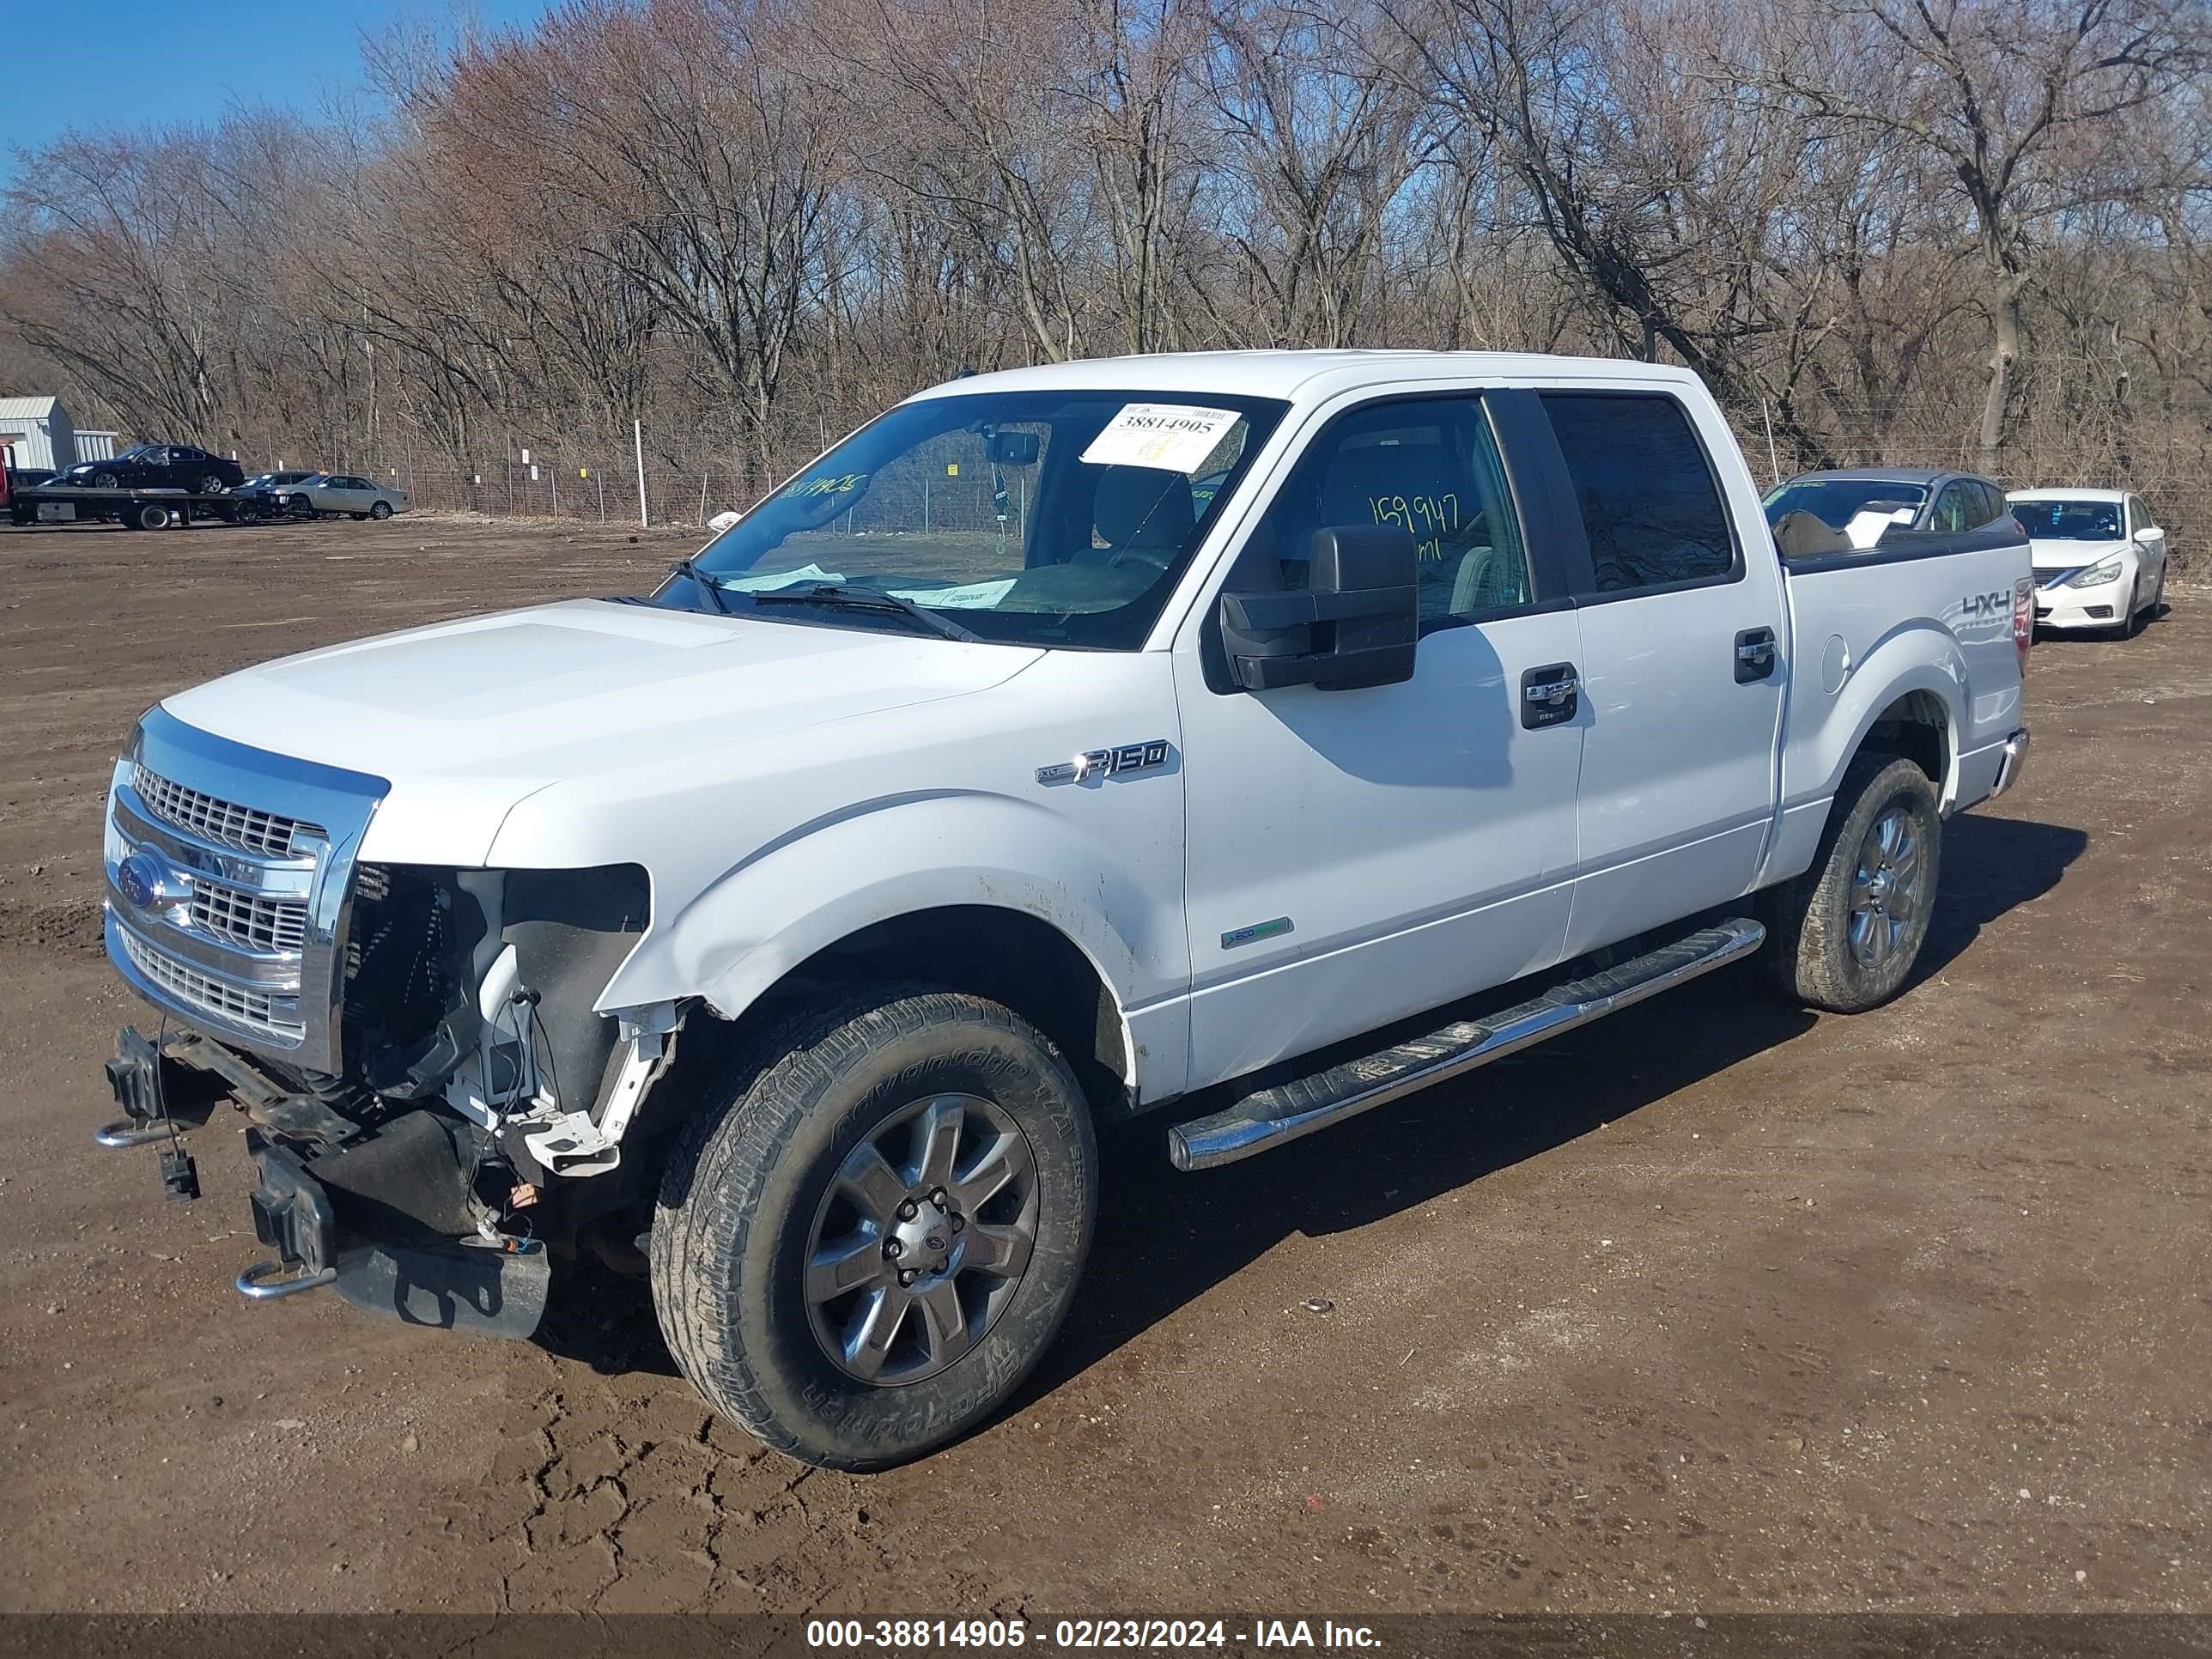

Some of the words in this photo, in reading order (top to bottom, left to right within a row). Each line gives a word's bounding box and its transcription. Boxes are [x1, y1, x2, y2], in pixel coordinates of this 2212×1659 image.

[1119, 416, 1215, 434] 38814905
[1042, 768, 1059, 777] XLT
[801, 1347, 1023, 1443] BFGoodrich
